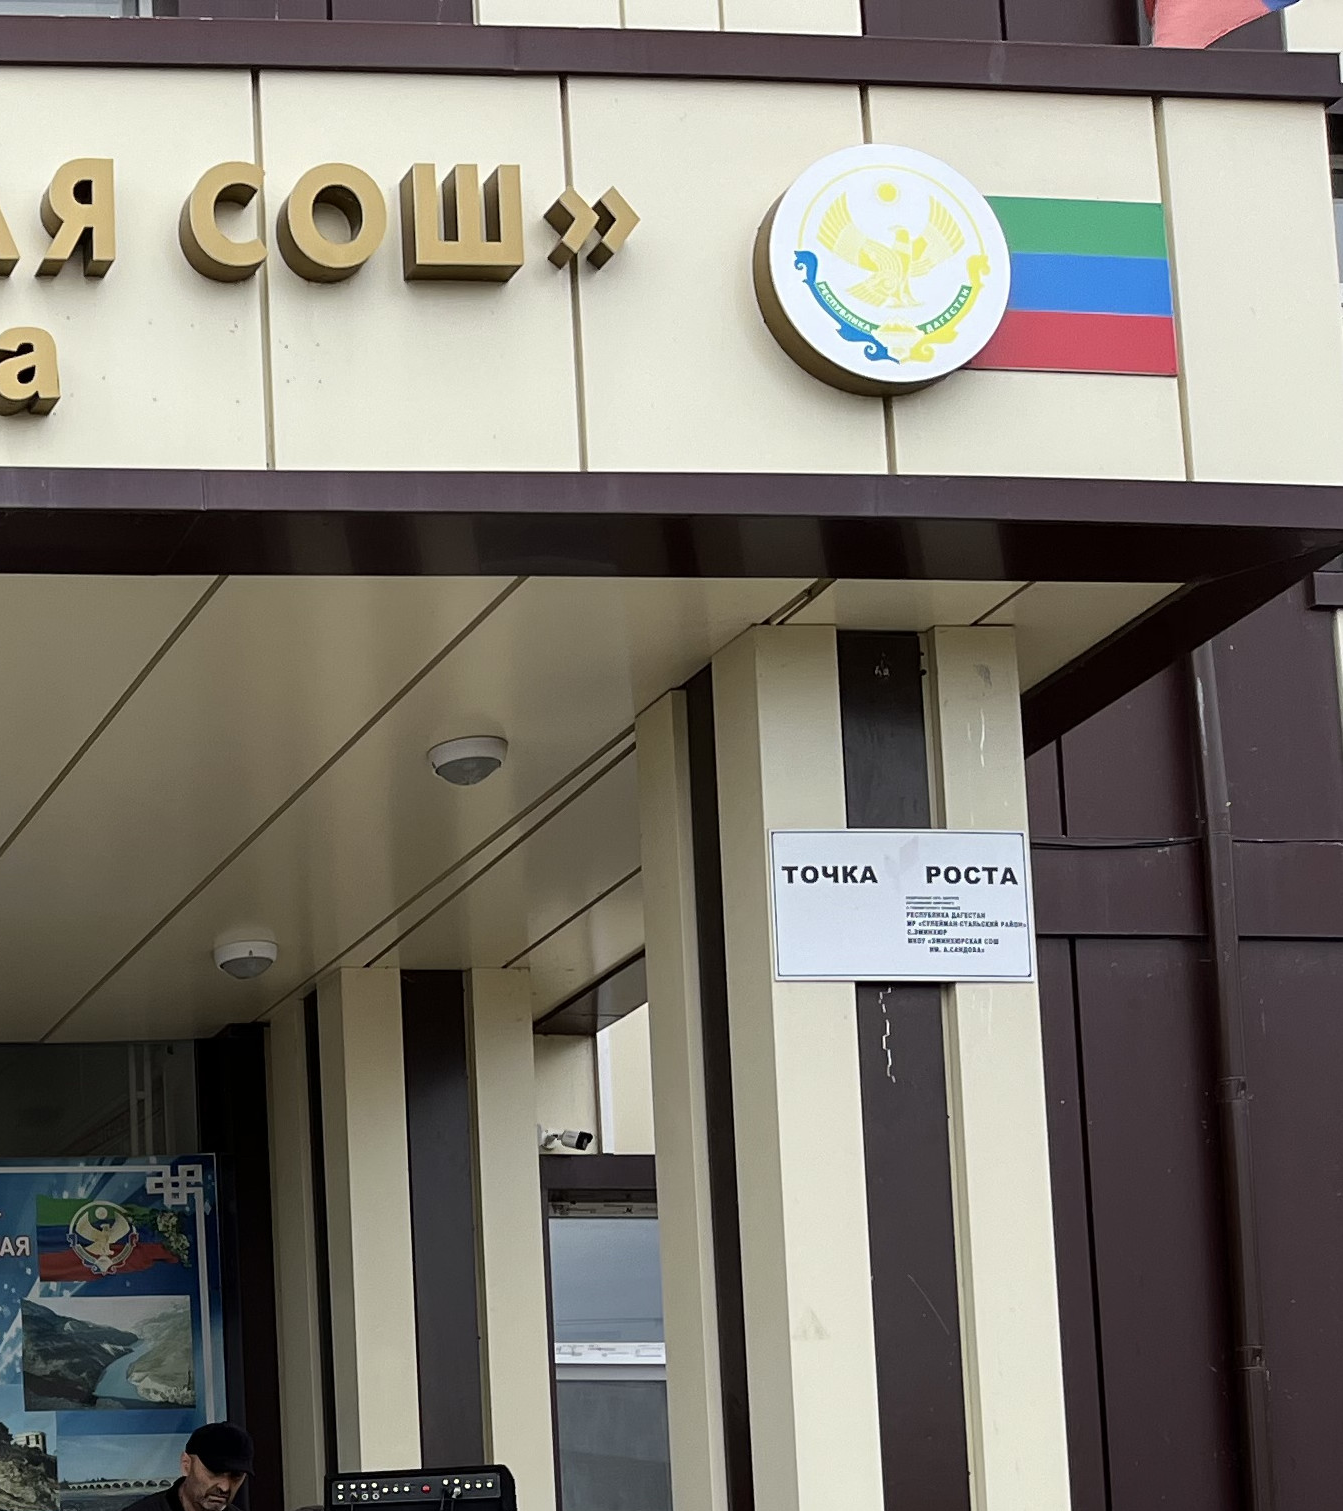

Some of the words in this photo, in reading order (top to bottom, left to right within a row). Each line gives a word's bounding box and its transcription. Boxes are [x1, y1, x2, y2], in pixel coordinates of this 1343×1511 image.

[178, 160, 641, 283] СОШ»
[781, 865, 878, 884] ТОЧКА
[925, 866, 1019, 885] РОСТА
